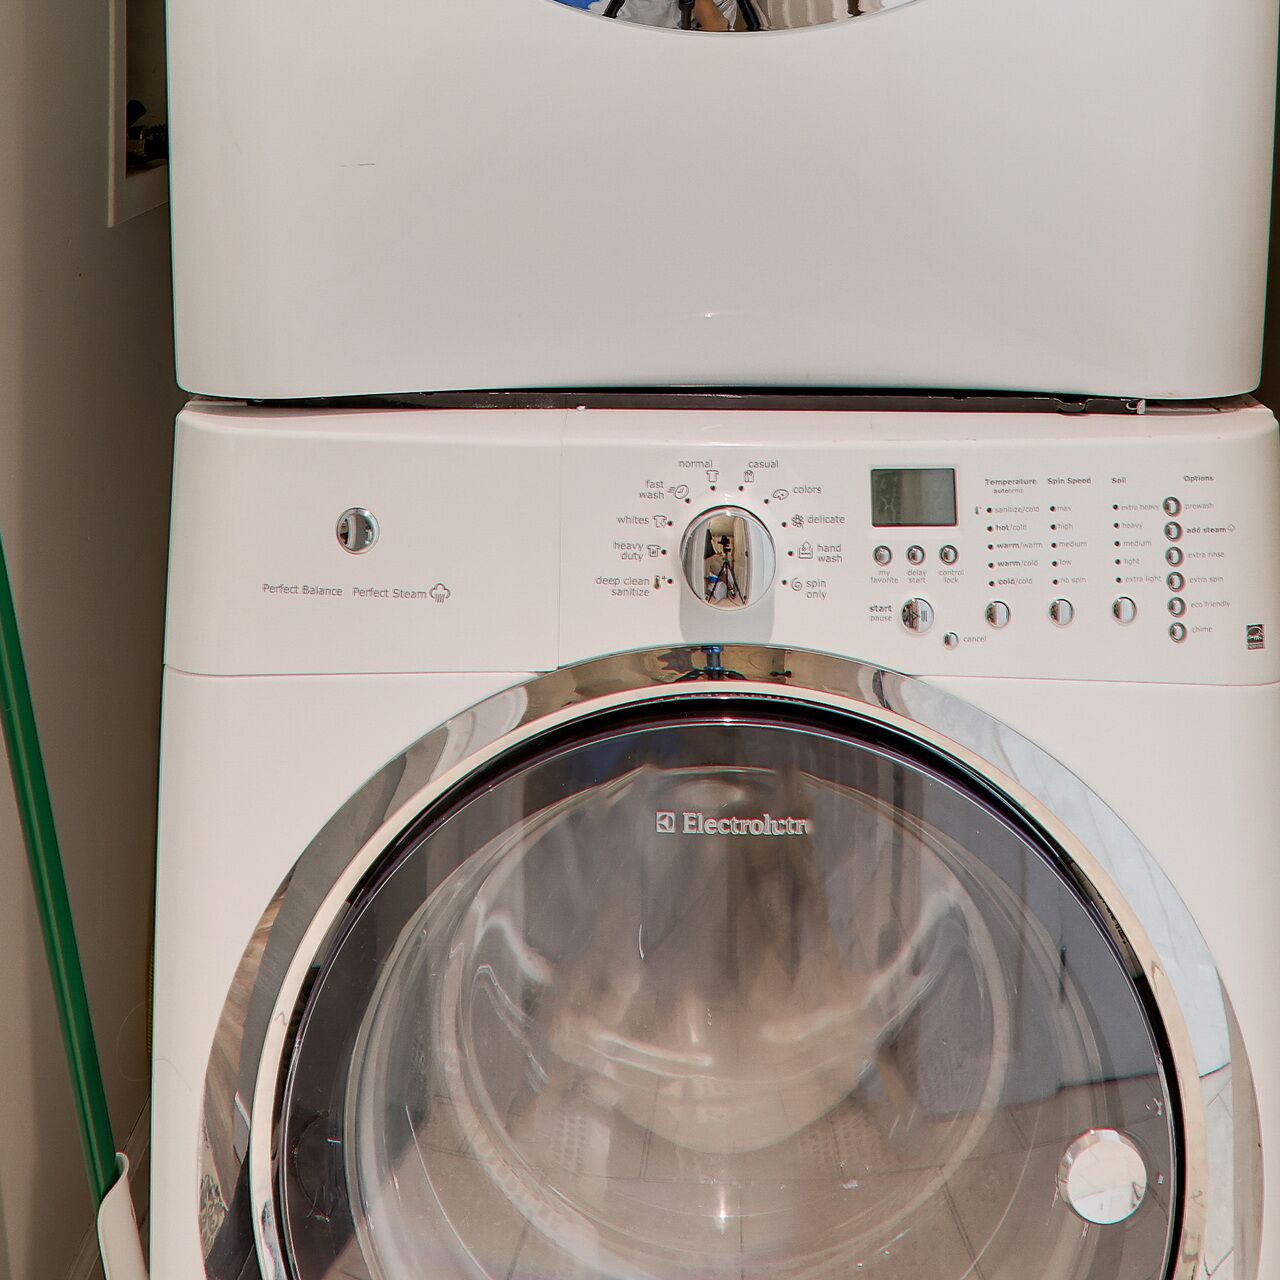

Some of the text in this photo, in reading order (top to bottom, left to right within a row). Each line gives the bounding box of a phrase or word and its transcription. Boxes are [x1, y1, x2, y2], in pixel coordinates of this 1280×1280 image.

[678, 459, 713, 468] normal
[748, 459, 779, 469] casual
[984, 478, 1037, 488] Temperature
[1047, 477, 1092, 486] Spin Speed
[1111, 477, 1127, 485] Soil
[1184, 474, 1214, 483] Options
[645, 479, 665, 489] fast
[793, 484, 822, 494] colors
[639, 490, 665, 499] wash
[616, 515, 650, 524] whites
[807, 514, 846, 524] delicate
[1186, 526, 1227, 534] add steam
[613, 540, 644, 551] heavy
[817, 543, 842, 552] hand
[1058, 540, 1088, 548] medium
[620, 551, 644, 562] duty
[817, 554, 843, 563] wash
[907, 569, 927, 577] delay
[595, 575, 650, 587] deep clean
[806, 578, 827, 589] spin
[998, 577, 1033, 585] cold/cold
[262, 582, 343, 597] Perfect Balance
[352, 586, 427, 599] Perfect Steam
[611, 587, 650, 597] sanitize
[806, 590, 828, 600] only
[869, 604, 893, 613] start
[1204, 600, 1231, 610] friendly
[870, 615, 893, 623] pause
[963, 635, 987, 643] cancel
